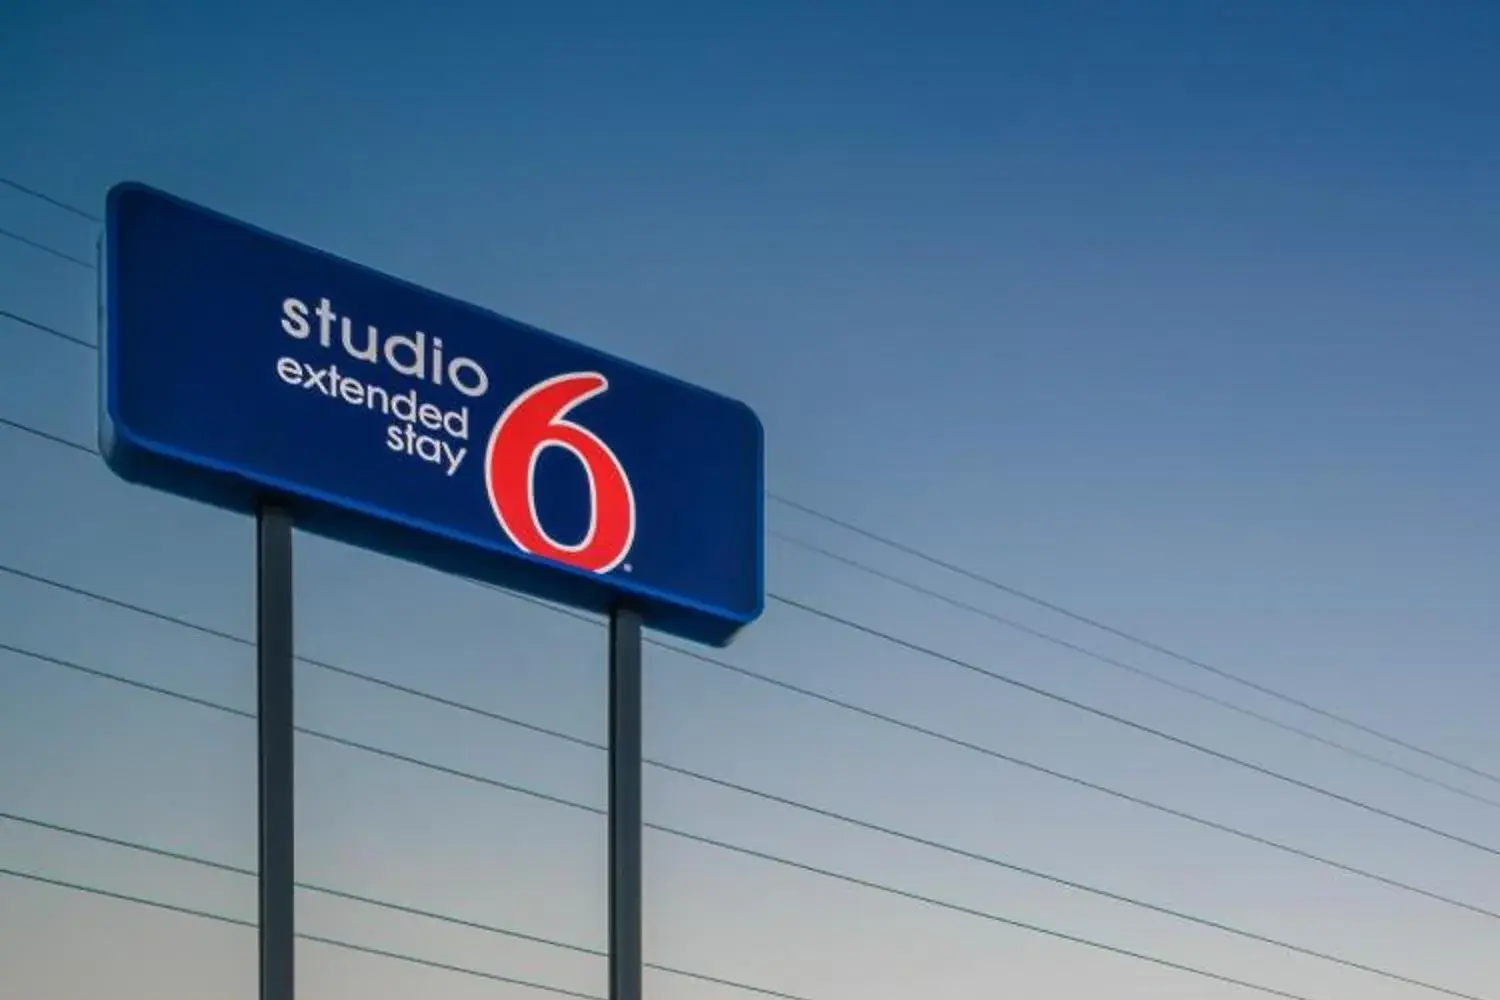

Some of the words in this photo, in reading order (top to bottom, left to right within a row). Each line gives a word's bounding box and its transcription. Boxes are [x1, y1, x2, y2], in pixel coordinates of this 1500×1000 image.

[281, 297, 489, 396] studio
[277, 354, 469, 440] extended
[386, 422, 468, 476] stay
[485, 371, 636, 574] 6
